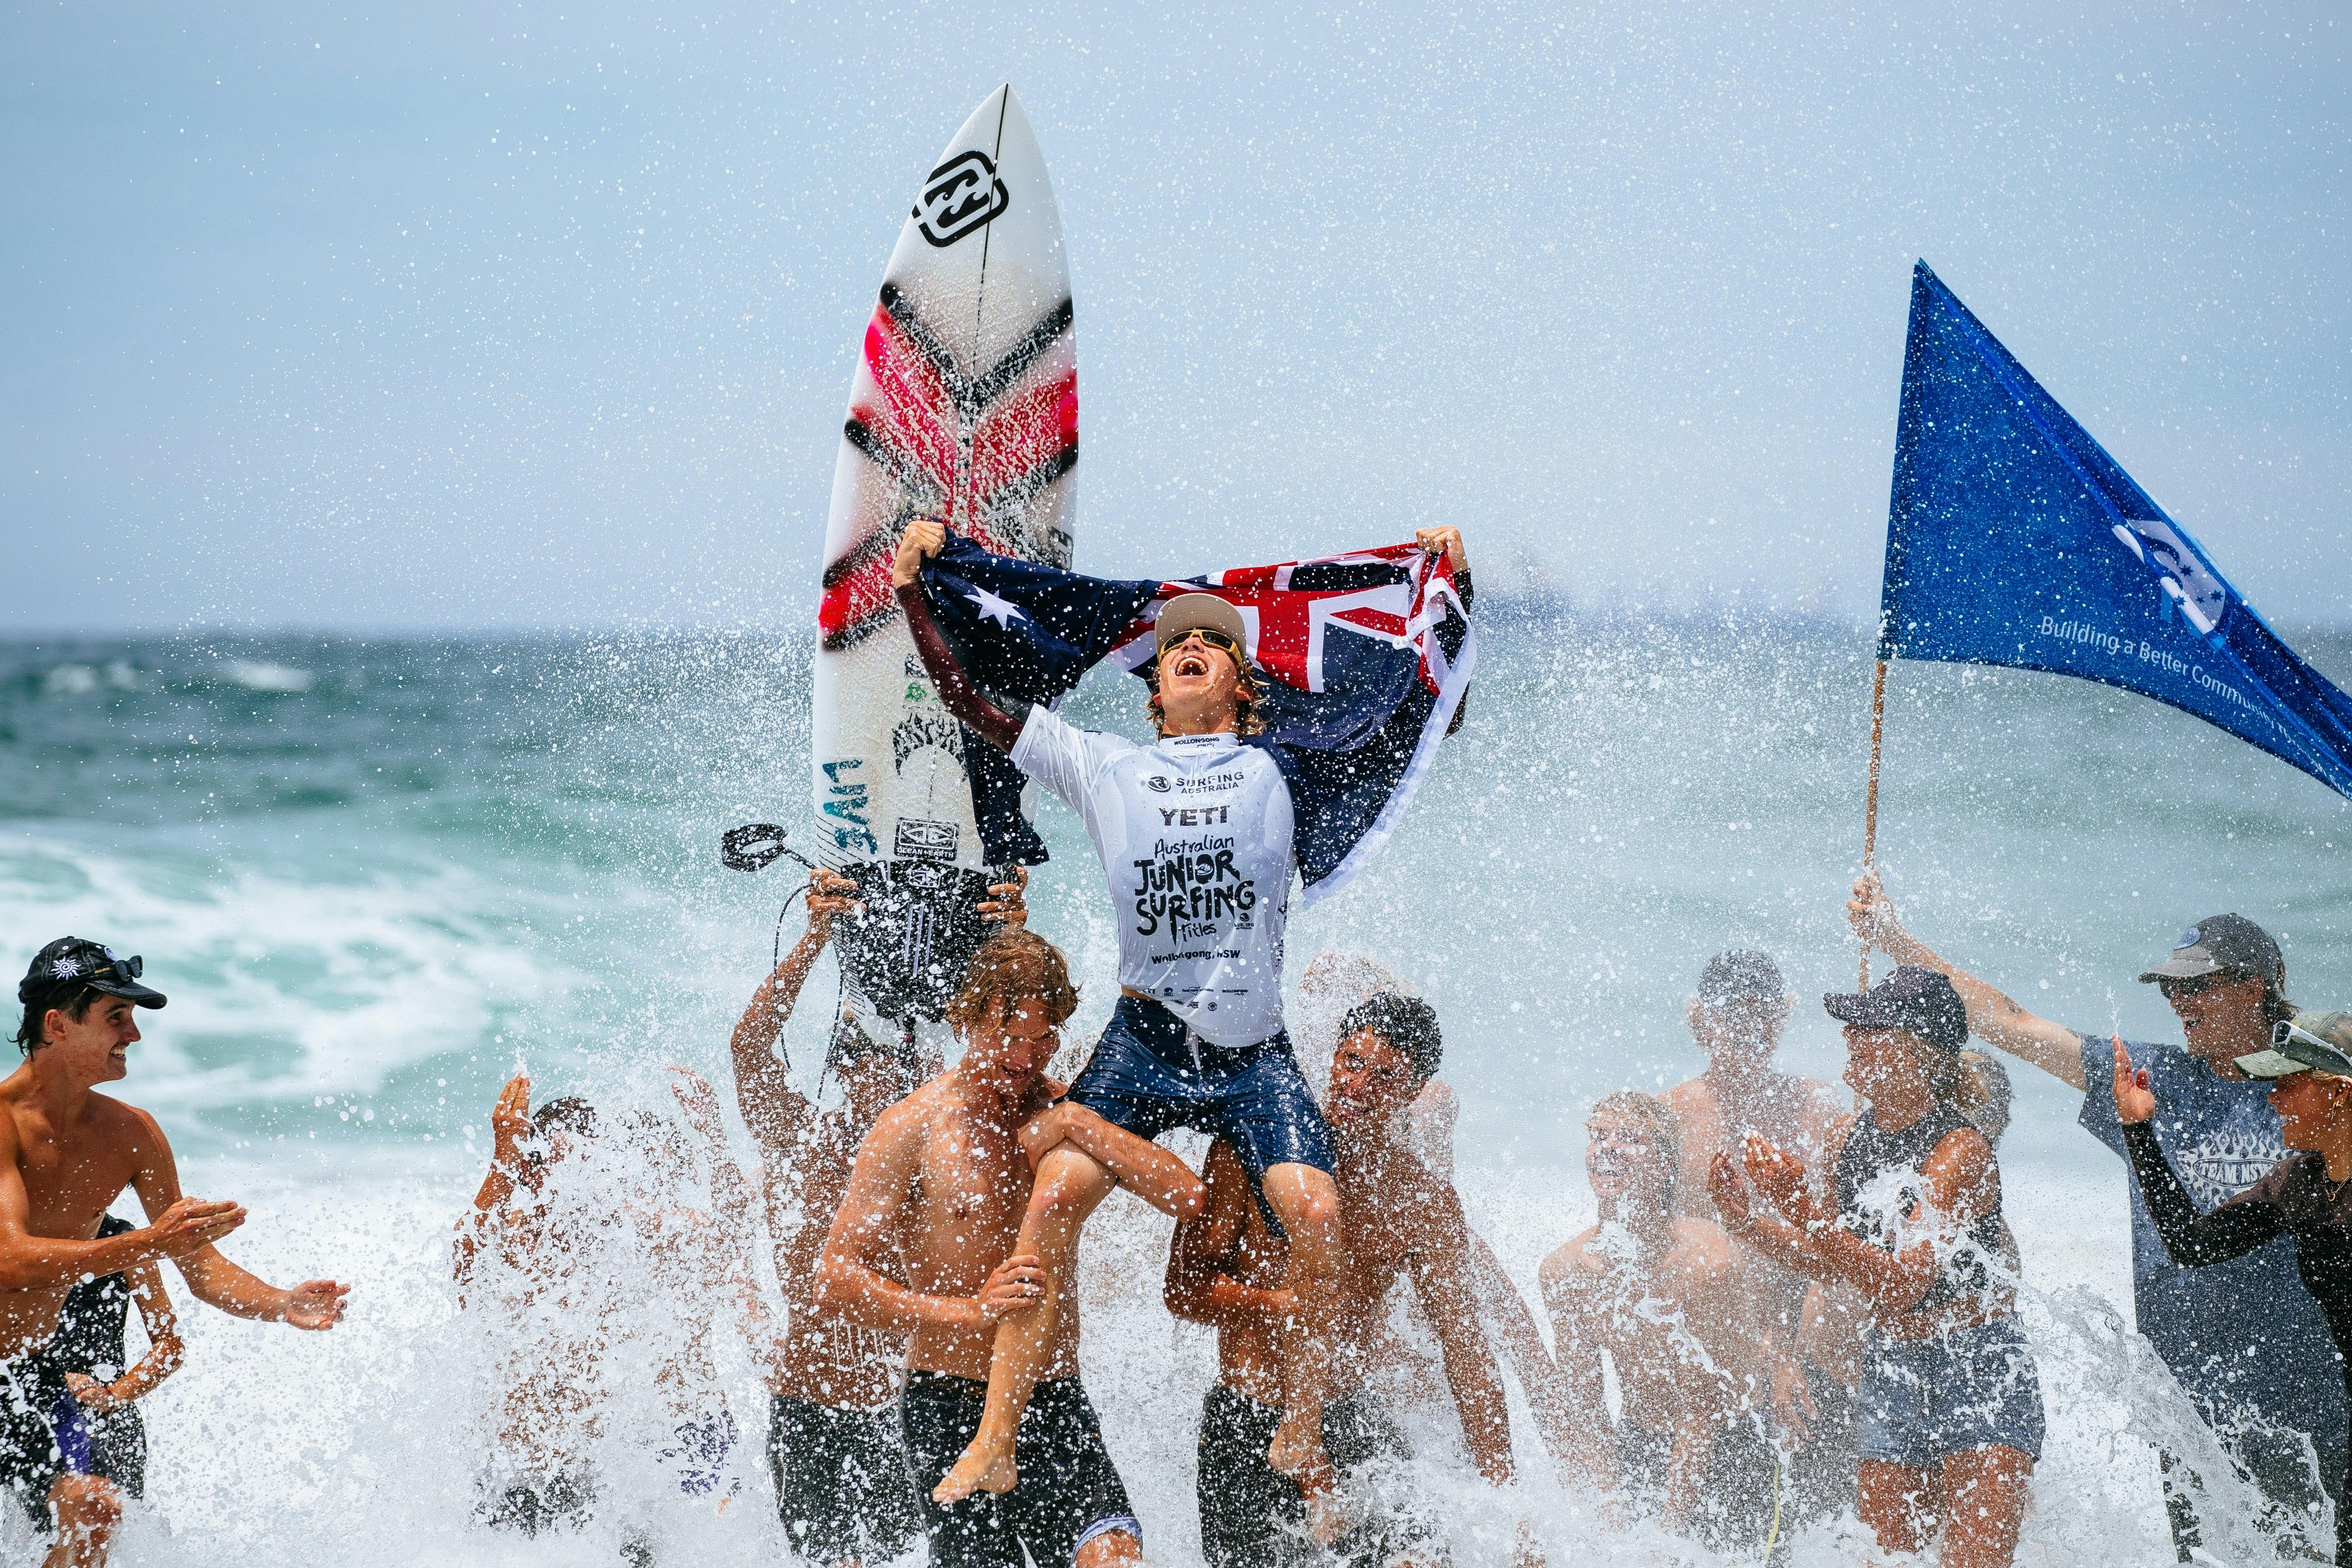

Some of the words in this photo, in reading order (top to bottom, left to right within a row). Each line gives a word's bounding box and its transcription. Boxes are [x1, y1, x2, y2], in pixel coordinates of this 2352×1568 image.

[2041, 616, 2119, 655] Building
[2123, 639, 2133, 654] a
[2139, 641, 2188, 676] Better
[2192, 664, 2274, 729] Community
[1174, 737, 1220, 745] WOLLONGONG
[1176, 771, 1244, 787] SURFING
[1181, 782, 1239, 794] AUSTRALIA
[1158, 805, 1227, 826] YETI
[897, 846, 923, 855] OCEAN
[929, 850, 954, 858] EARTH
[1154, 834, 1234, 861] Australian
[1134, 850, 1241, 896] JUNIOR
[1136, 880, 1256, 946] SURFING
[1178, 922, 1217, 942] Titles
[1216, 949, 1241, 959] NSW
[2201, 1162, 2237, 1184] TEAM
